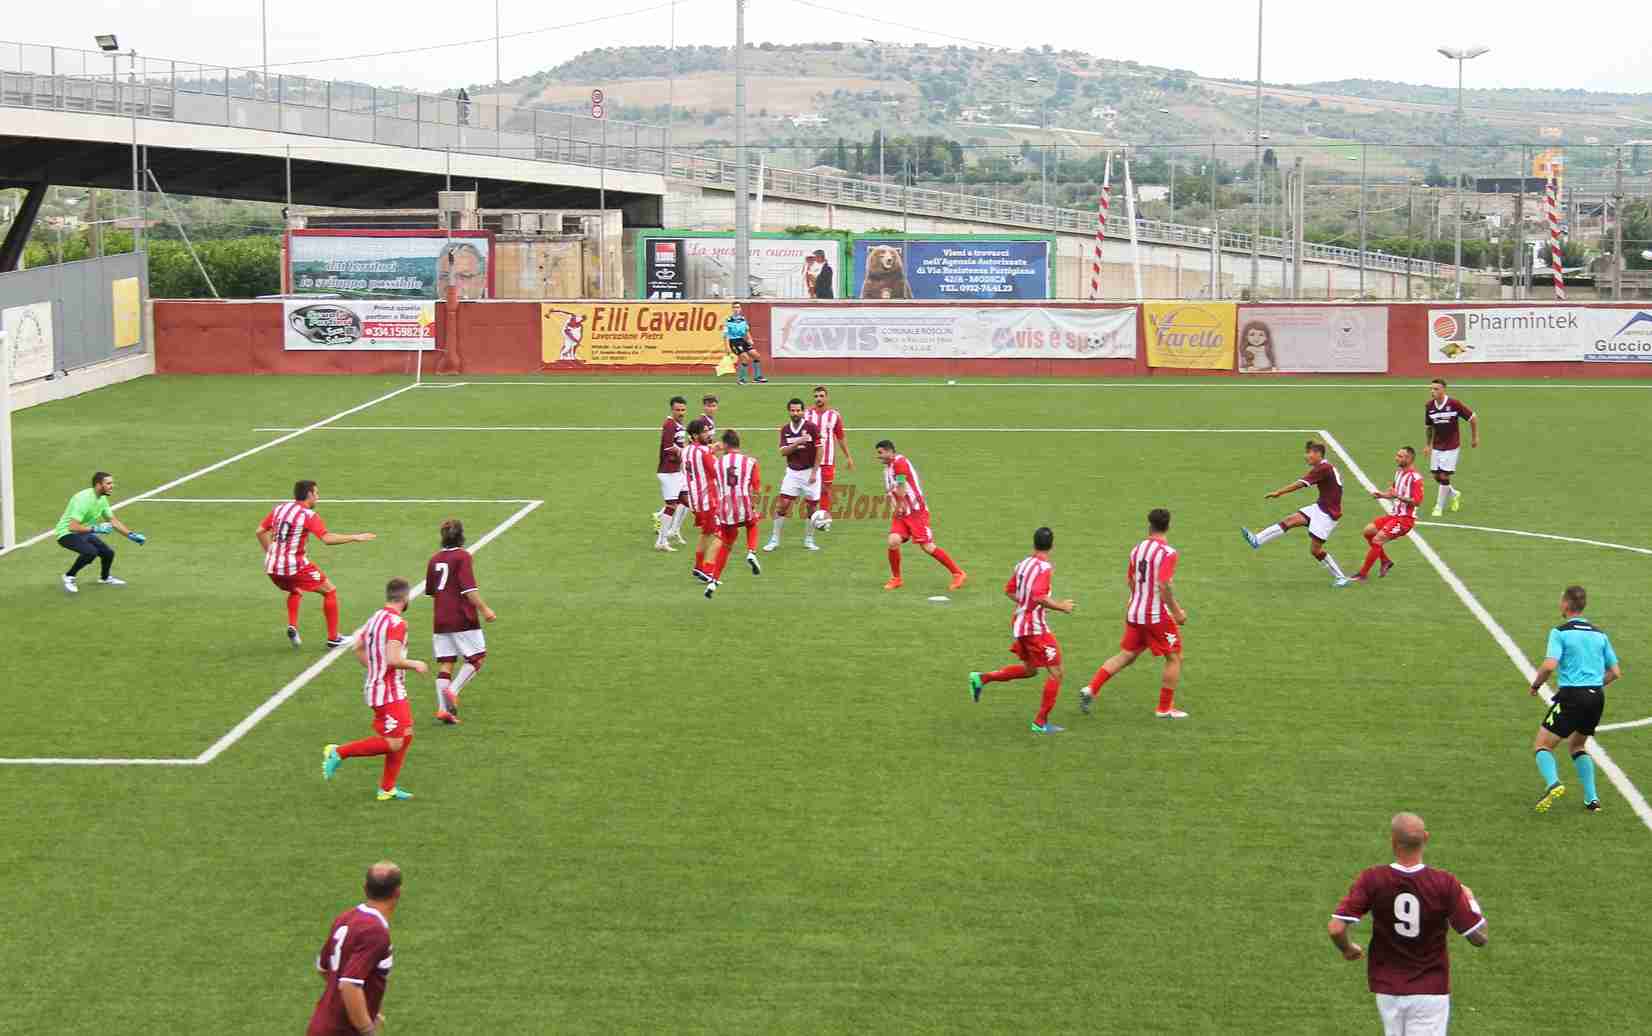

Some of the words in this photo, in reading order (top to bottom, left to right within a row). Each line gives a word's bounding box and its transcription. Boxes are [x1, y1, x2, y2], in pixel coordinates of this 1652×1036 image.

[943, 248, 966, 257] Vieni
[974, 248, 1009, 257] trovarci
[926, 266, 942, 274] Via
[368, 276, 423, 290] possibile
[591, 307, 629, 332] F.lli
[1468, 312, 1578, 330] Pharmintek
[434, 562, 449, 591] 7
[1393, 892, 1421, 939] 9
